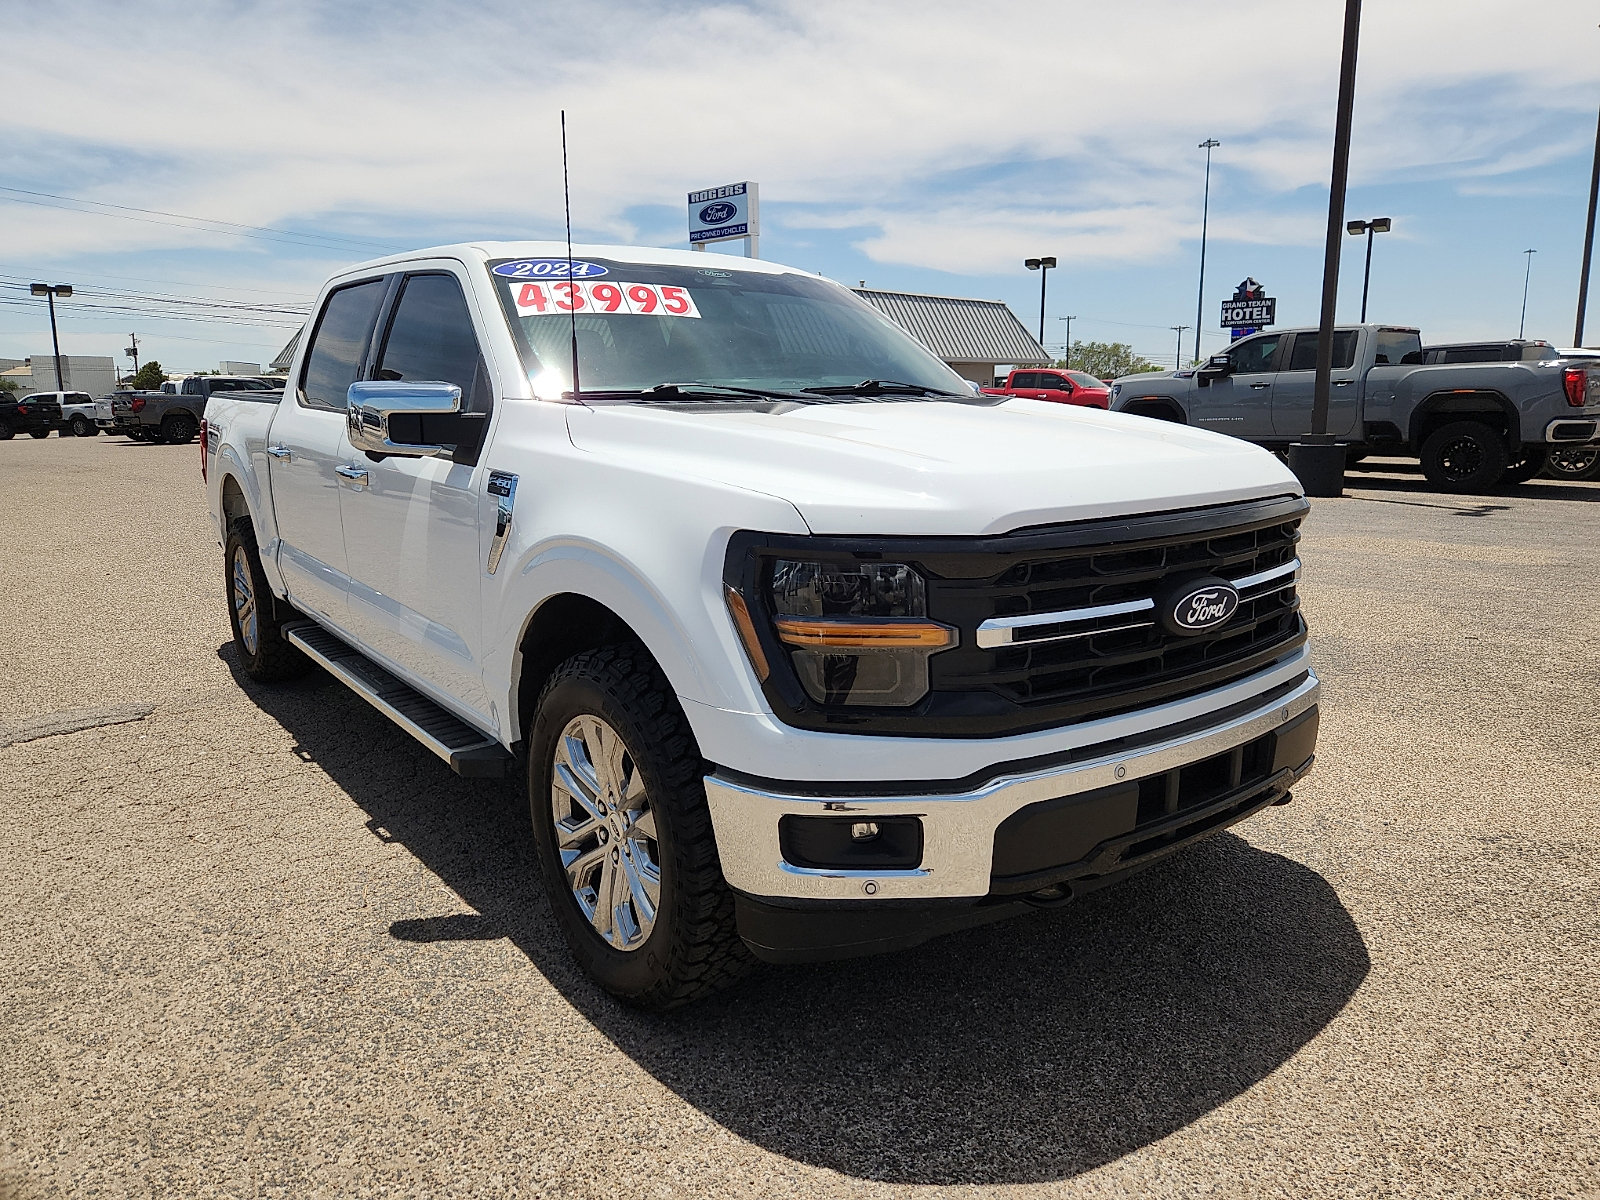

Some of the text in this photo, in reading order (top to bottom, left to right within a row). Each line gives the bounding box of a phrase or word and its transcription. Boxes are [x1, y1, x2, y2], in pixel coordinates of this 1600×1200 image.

[691, 184, 743, 202] ROGERS
[706, 205, 728, 220] Ford
[691, 225, 745, 239] PRE-OWNED VEHICLES
[512, 262, 590, 276] 2024
[517, 282, 692, 314] 43995
[1222, 299, 1272, 309] GRAND TEXAN
[1221, 307, 1270, 320] HOTEL
[1187, 592, 1227, 623] Ford
